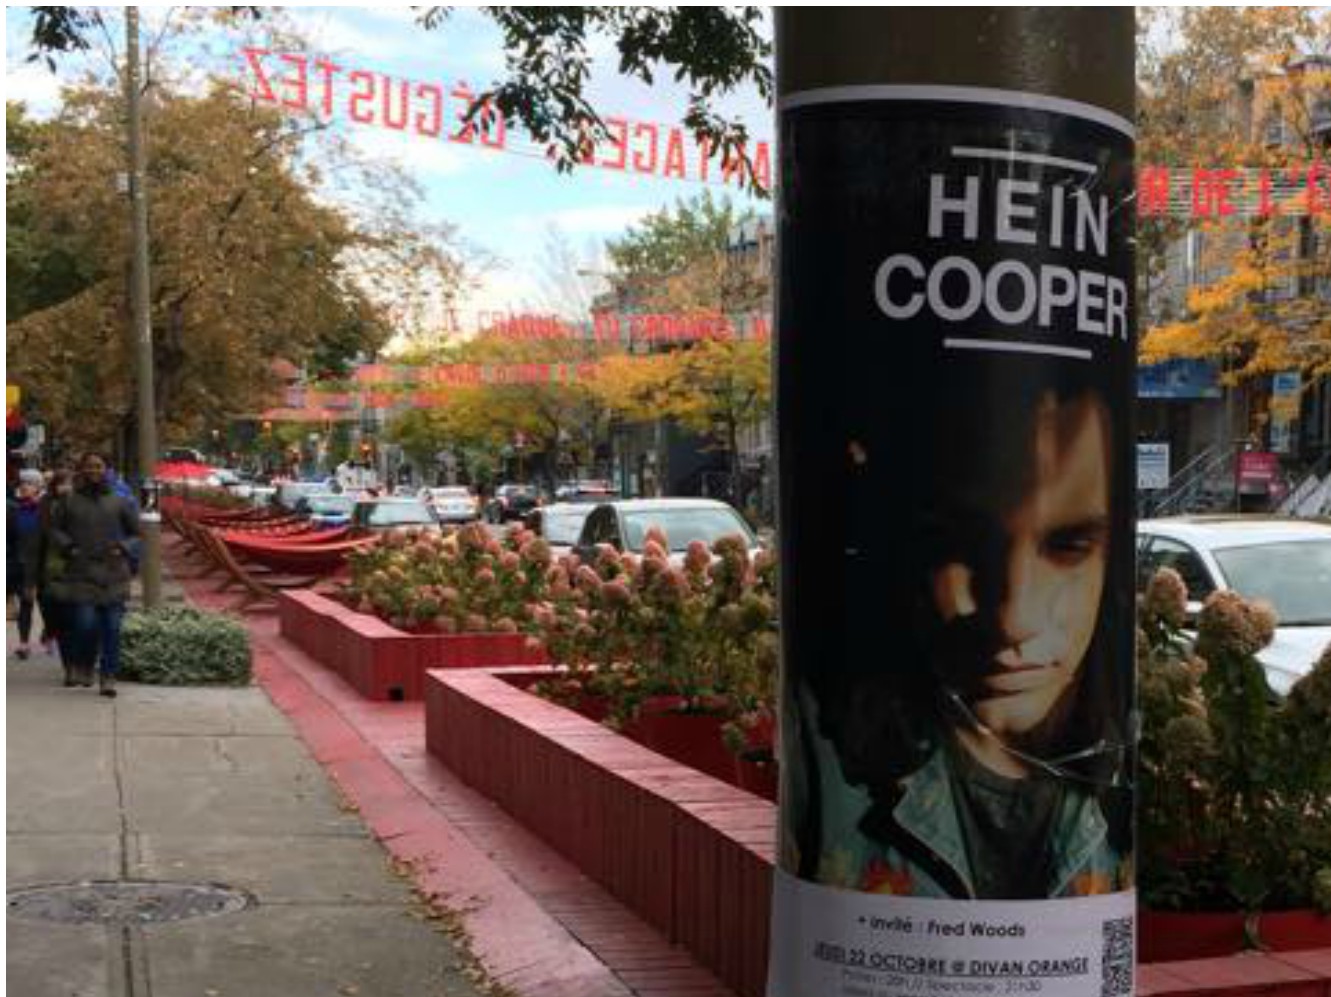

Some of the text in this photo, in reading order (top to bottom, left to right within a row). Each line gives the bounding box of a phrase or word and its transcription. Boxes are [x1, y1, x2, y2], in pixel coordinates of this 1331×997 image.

[928, 174, 1109, 257] HEIN
[875, 253, 1128, 340] COOPER
[928, 919, 965, 936] Fred
[970, 921, 1025, 937] Woods
[870, 952, 945, 974] OCTOBRE
[971, 960, 1022, 975] DIVAN
[1027, 957, 1088, 976] ORANGE
